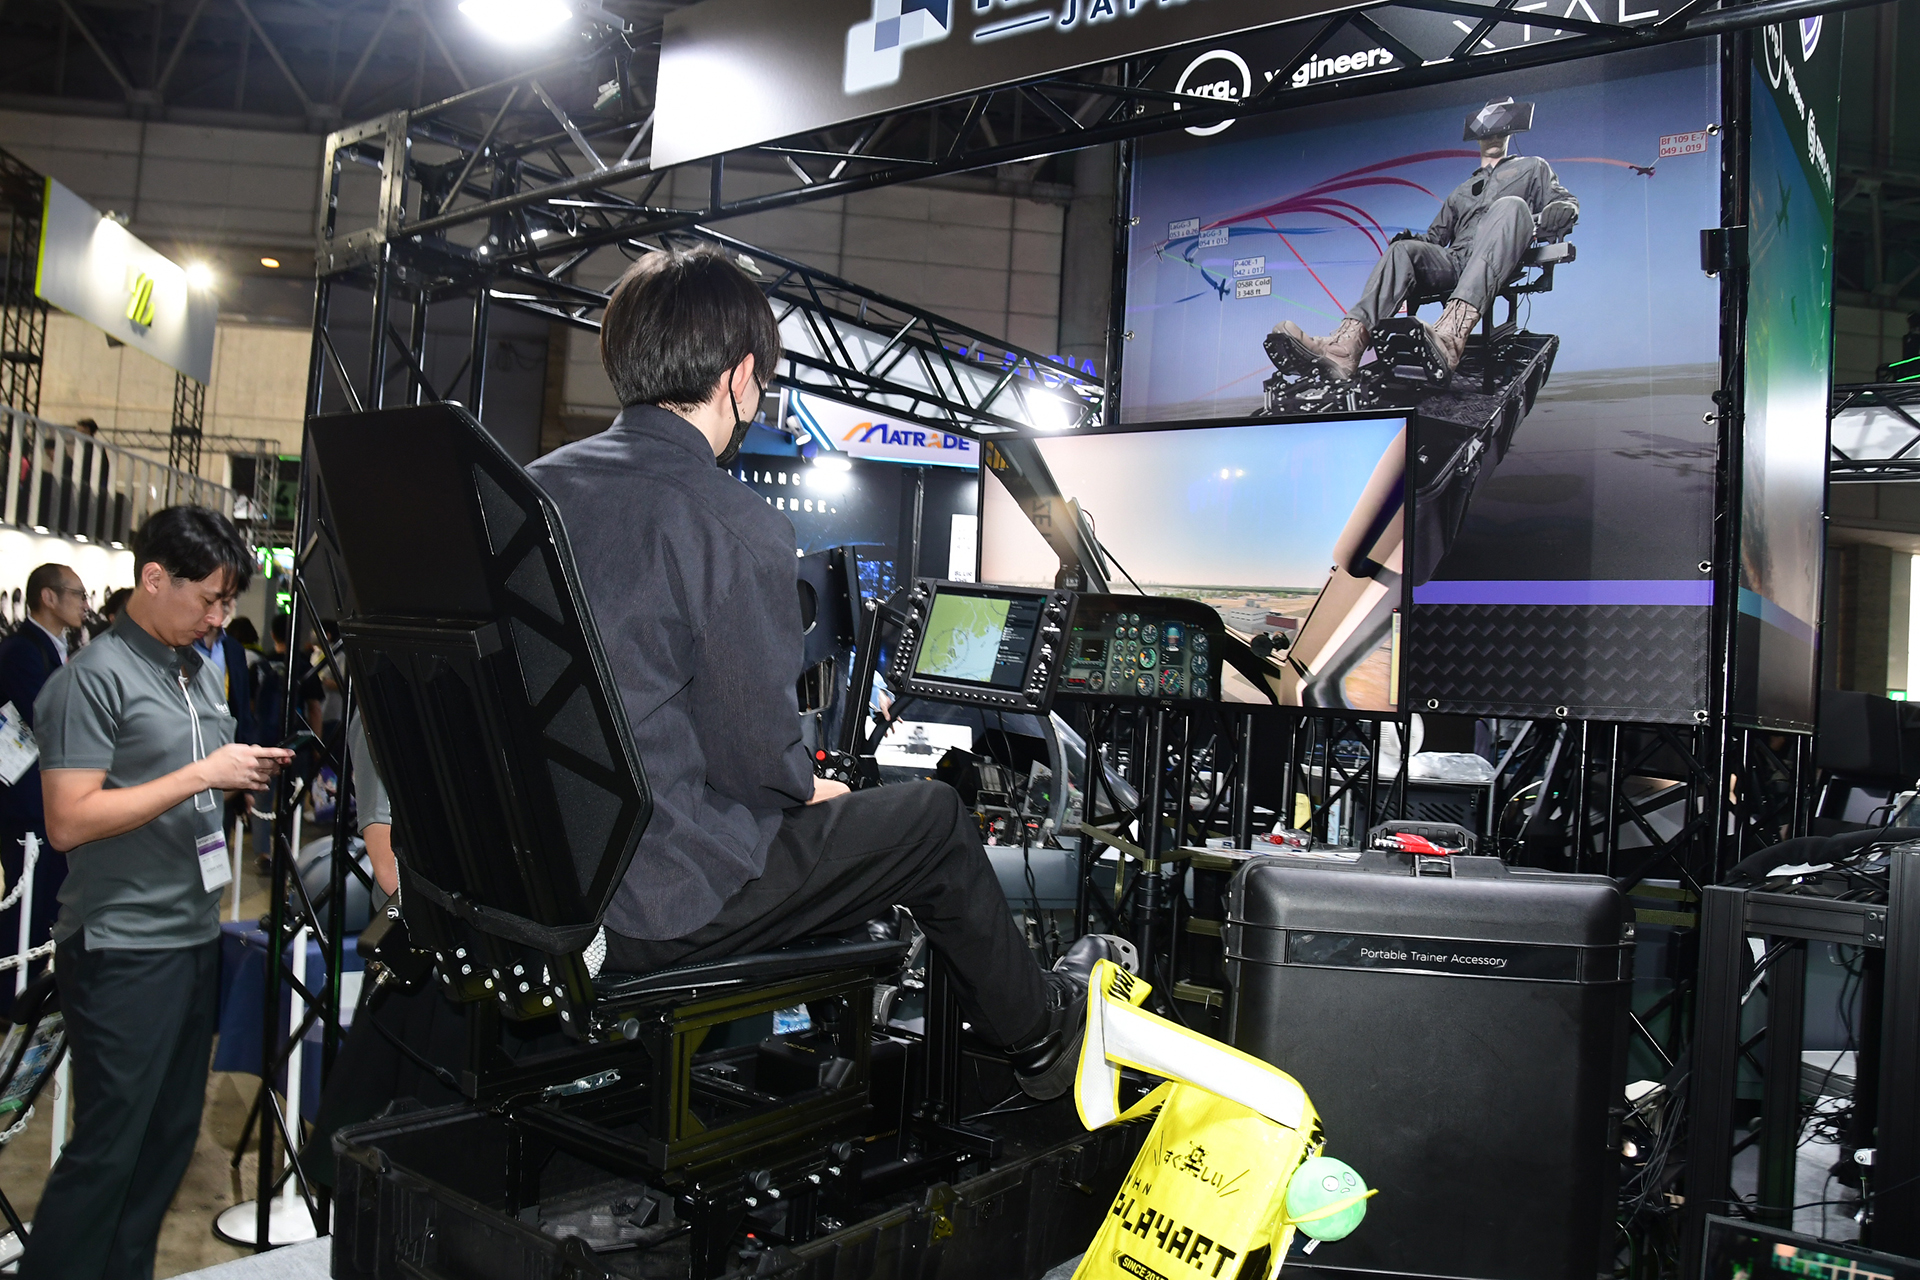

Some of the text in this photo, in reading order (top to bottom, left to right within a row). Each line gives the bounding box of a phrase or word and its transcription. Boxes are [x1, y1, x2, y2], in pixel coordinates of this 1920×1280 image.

[1264, 47, 1394, 88] vgineers
[1660, 143, 1702, 155] 049 019
[1661, 133, 1706, 145] Bf 109 E-7
[1252, 266, 1264, 274] 017
[1254, 277, 1271, 286] Cold
[842, 422, 970, 451] MATRADE
[1360, 947, 1508, 969] Portable Trainer Accessory
[1163, 1140, 1224, 1188] すぐ楽しい
[1122, 1257, 1148, 1279] SINCE
